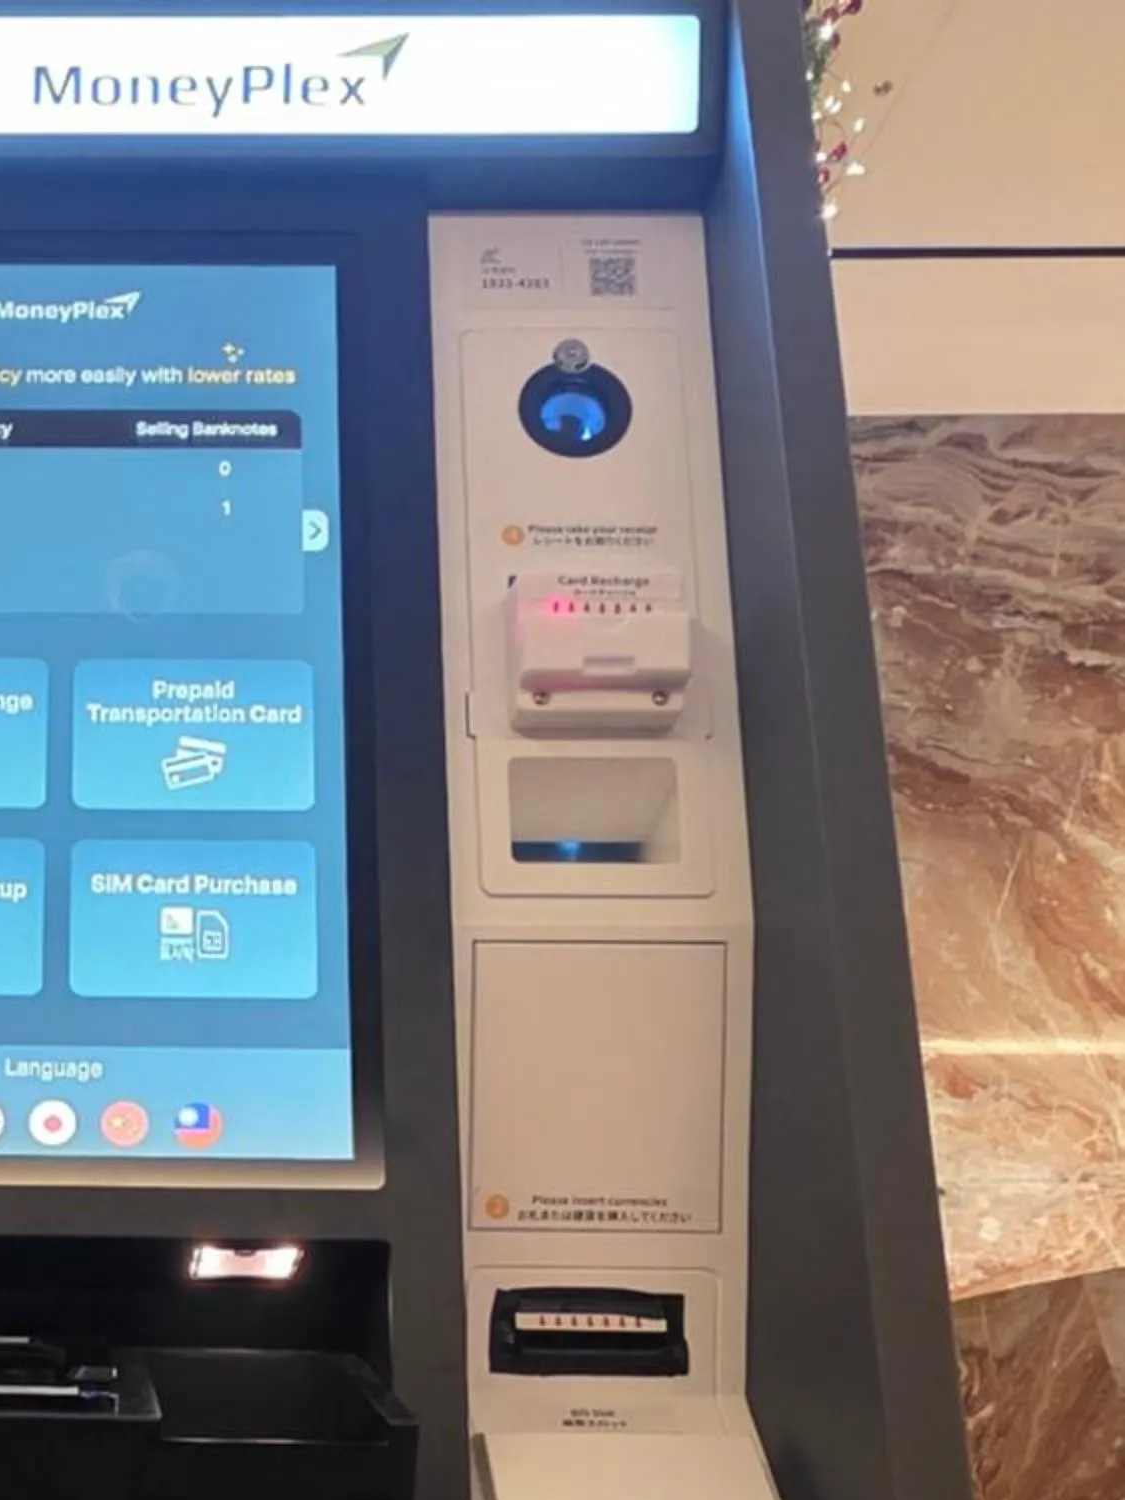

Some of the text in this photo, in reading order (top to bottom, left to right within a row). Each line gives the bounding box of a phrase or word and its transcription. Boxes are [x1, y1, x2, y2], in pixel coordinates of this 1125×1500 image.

[33, 62, 366, 118] MoneyPlex
[26, 368, 77, 383] more
[80, 366, 137, 386] easily
[140, 366, 184, 383] with
[187, 366, 242, 384] lower
[245, 368, 297, 384] rates
[135, 421, 279, 439] Selling Banknotes
[218, 460, 232, 477] 0
[221, 500, 231, 516] 1
[557, 574, 589, 587] Card
[152, 679, 236, 703] Prepaid
[86, 703, 303, 727] Transportation Card
[90, 873, 298, 896] SIM Card Purchase
[3, 1056, 104, 1081] Language
